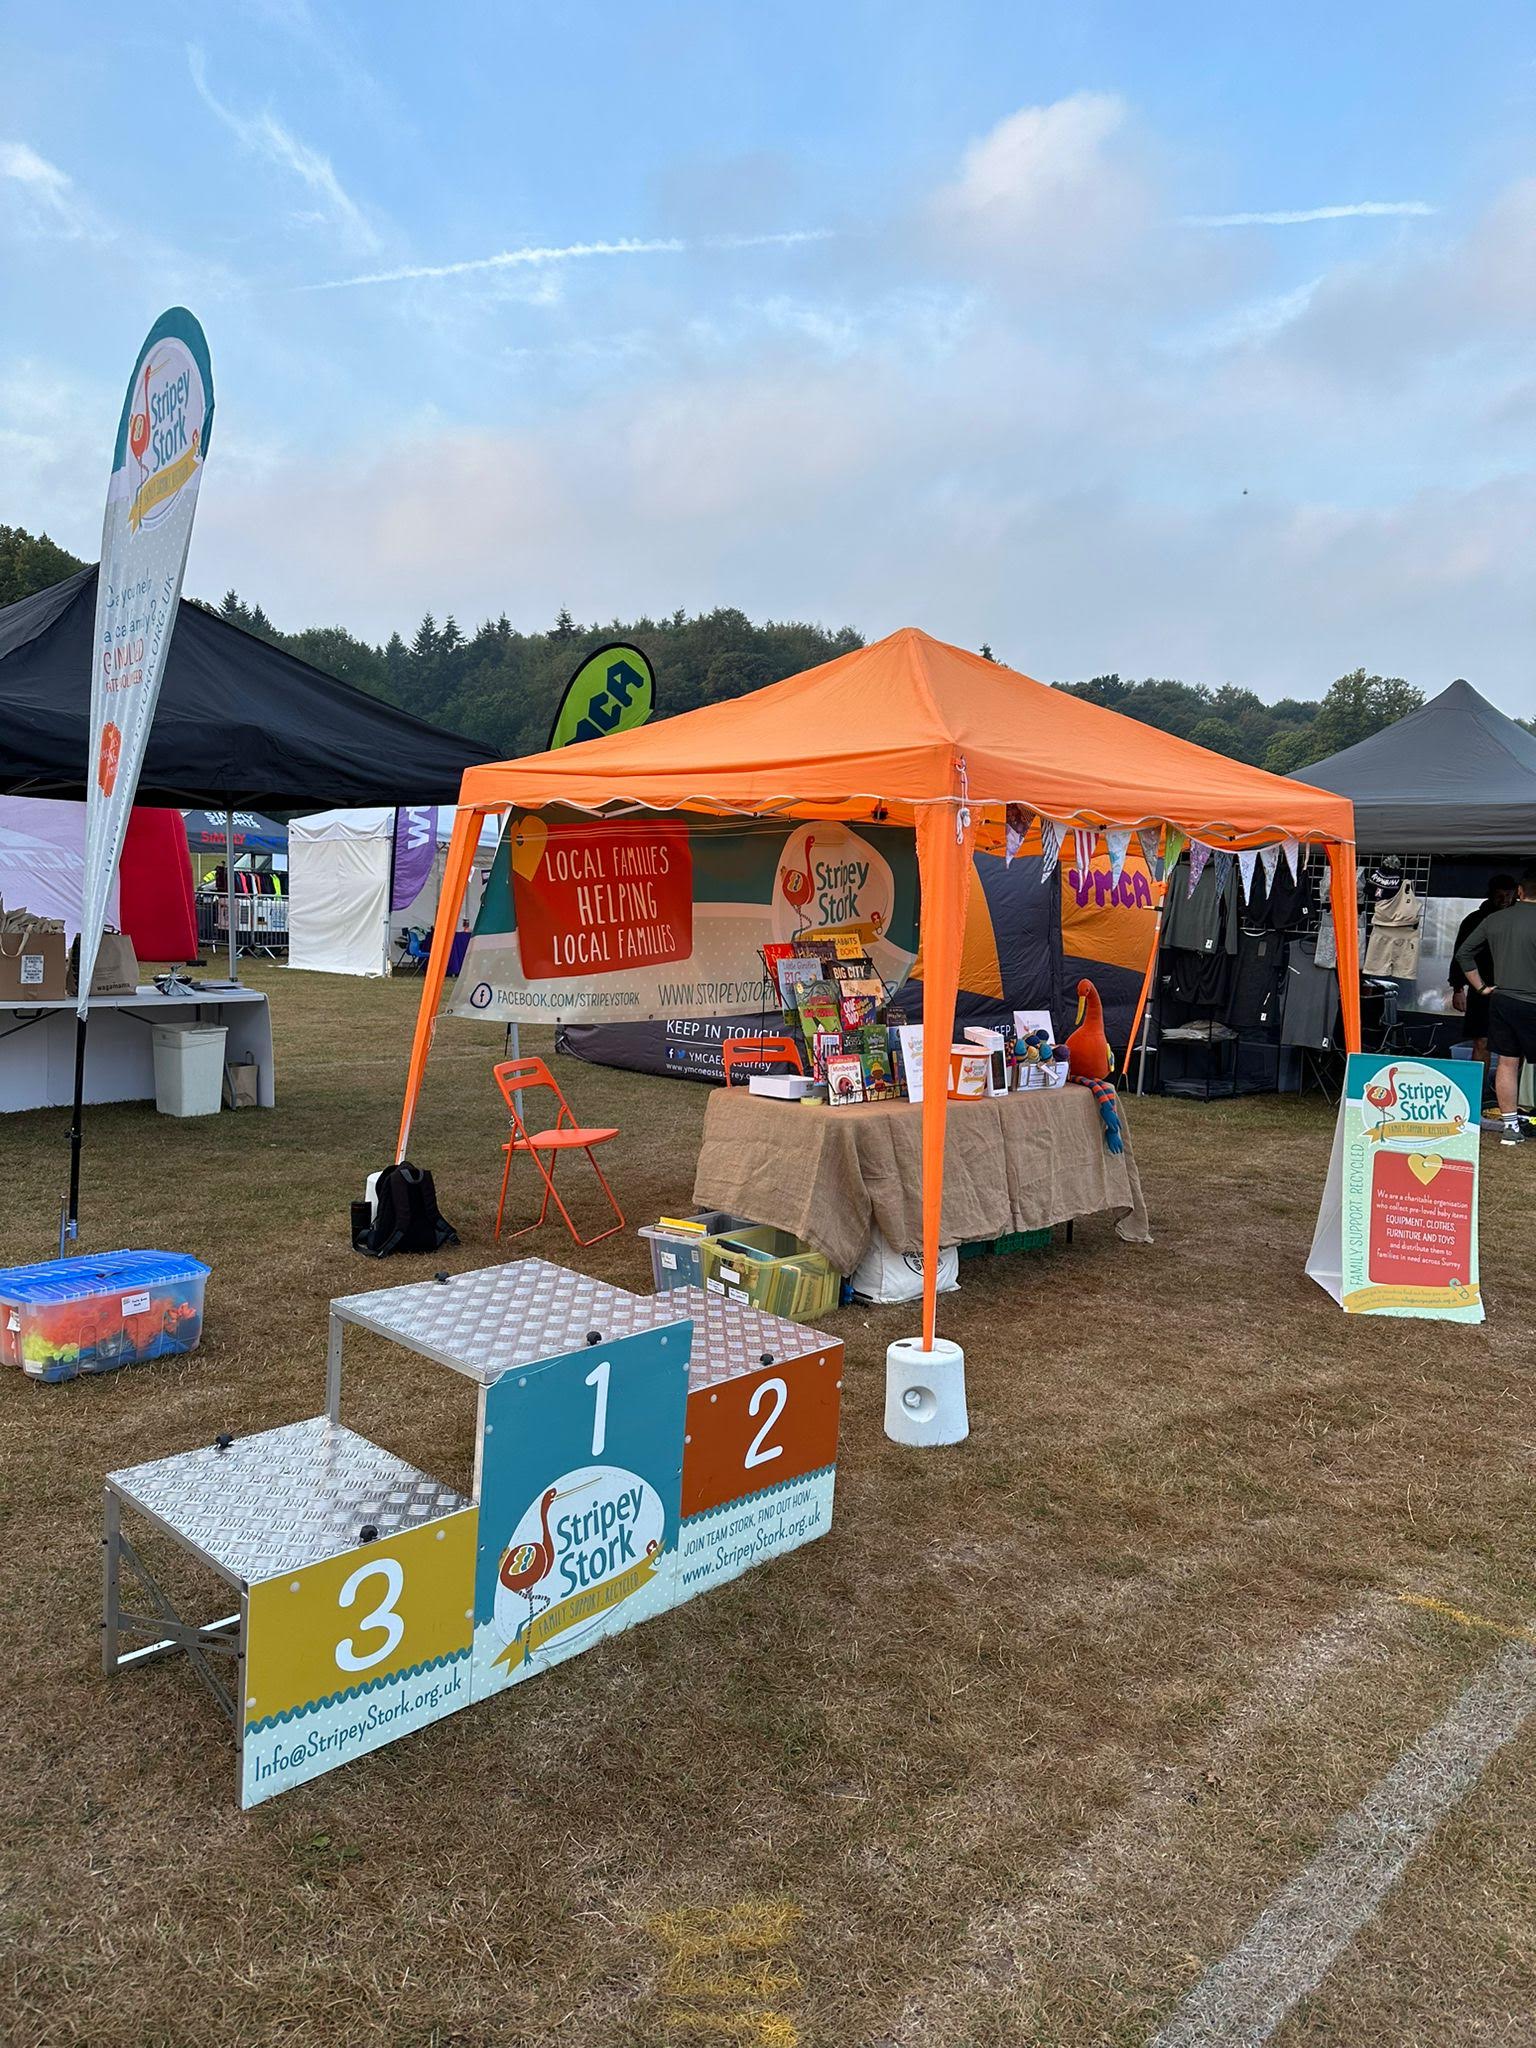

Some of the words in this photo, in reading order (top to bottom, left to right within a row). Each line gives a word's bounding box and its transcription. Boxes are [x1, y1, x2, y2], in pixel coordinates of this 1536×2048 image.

[151, 369, 190, 430] Stripey
[152, 407, 187, 473] Stork
[545, 847, 606, 882] LOCAL
[613, 846, 669, 877] FAMILIES
[816, 860, 870, 893] Stripey
[577, 881, 657, 926] HELPING
[818, 886, 860, 926] Stork
[1068, 868, 1152, 909] YMCA
[553, 930, 611, 965] LOCAL
[618, 924, 676, 959] FAMILIES
[832, 967, 847, 980] BIG
[847, 965, 865, 979] CITY
[497, 989, 640, 1008] FACEBOOK.COM/STRIPEYSTORK
[666, 1019, 700, 1036] KEEP
[704, 1024, 721, 1039] IN
[1398, 1082, 1452, 1103] Stripey
[1400, 1099, 1448, 1121] Stork
[1376, 1189, 1388, 1199] We
[1404, 1192, 1432, 1204] charitable
[1433, 1200, 1468, 1209] organisation
[1389, 1202, 1408, 1212] collect
[1409, 1205, 1437, 1216] pre-loved
[1437, 1209, 1451, 1219] baby
[1451, 1212, 1468, 1220] items
[1376, 1248, 1399, 1260] families
[1407, 1254, 1420, 1263] need
[1386, 1228, 1421, 1241] FURNITURE
[1422, 1233, 1437, 1242] AND
[1438, 1235, 1456, 1245] TOYS
[1390, 1241, 1400, 1249] and
[1401, 1241, 1429, 1253] distribute
[1430, 1245, 1445, 1255] them
[1350, 1250, 1365, 1286] FAMILY
[585, 1361, 611, 1457] 1
[743, 1377, 788, 1470] 2
[556, 1484, 644, 1555] Stripey
[684, 1536, 705, 1558] JOIN
[707, 1527, 728, 1548] TEAM
[729, 1514, 756, 1538] STORK,
[758, 1506, 776, 1525] FIND
[776, 1496, 791, 1516] OUT
[560, 1523, 636, 1599] Stork
[682, 1501, 822, 1586] www.StripeyStork.org.uk
[334, 1557, 405, 1673] 3
[538, 1607, 566, 1638] FAMILY
[255, 1667, 462, 1782] Info@StripeyStork.org.uk
